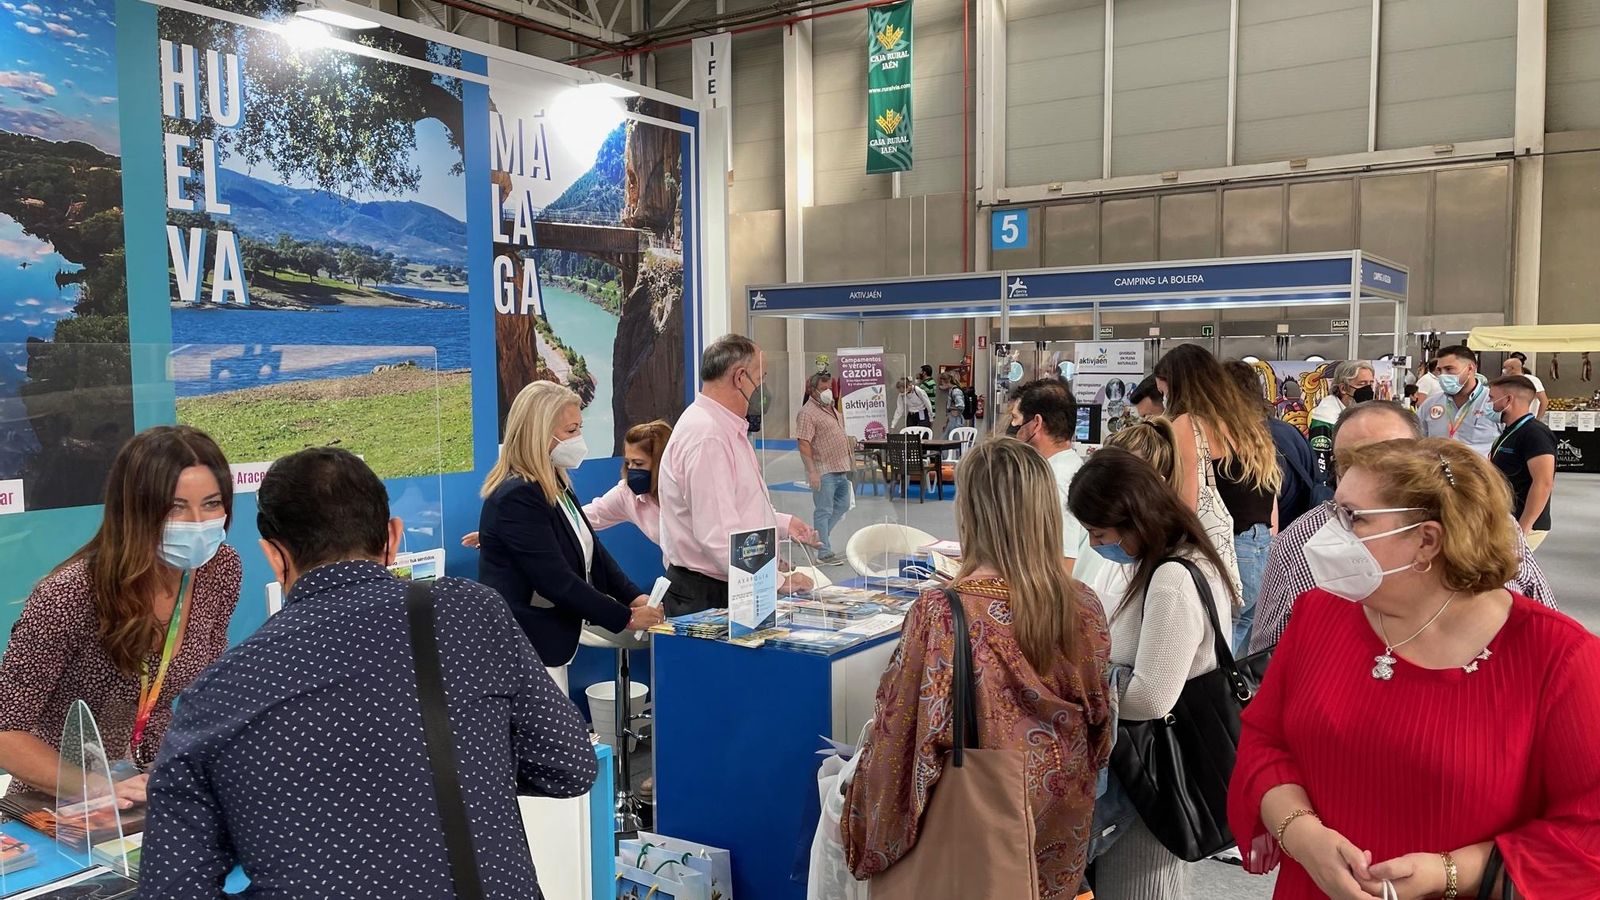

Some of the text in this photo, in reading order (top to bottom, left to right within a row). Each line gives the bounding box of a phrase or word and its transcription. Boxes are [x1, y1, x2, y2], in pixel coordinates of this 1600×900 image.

[887, 51, 910, 61] RURAL
[160, 39, 243, 126] HU
[869, 83, 911, 94] www.ruralvia.com
[489, 108, 551, 180] MÁ
[887, 135, 909, 145] RURAL
[164, 133, 232, 215] EL
[491, 184, 537, 247] LA
[1001, 214, 1020, 244] 5
[167, 224, 250, 305] VA
[492, 253, 546, 316] GA
[1114, 274, 1205, 287] CAMPING LA BOLERA
[849, 291, 882, 300] AKTIVJAÉN
[840, 356, 882, 365] Campamentos
[842, 366, 883, 379] cazorla
[236, 471, 267, 485] Arace
